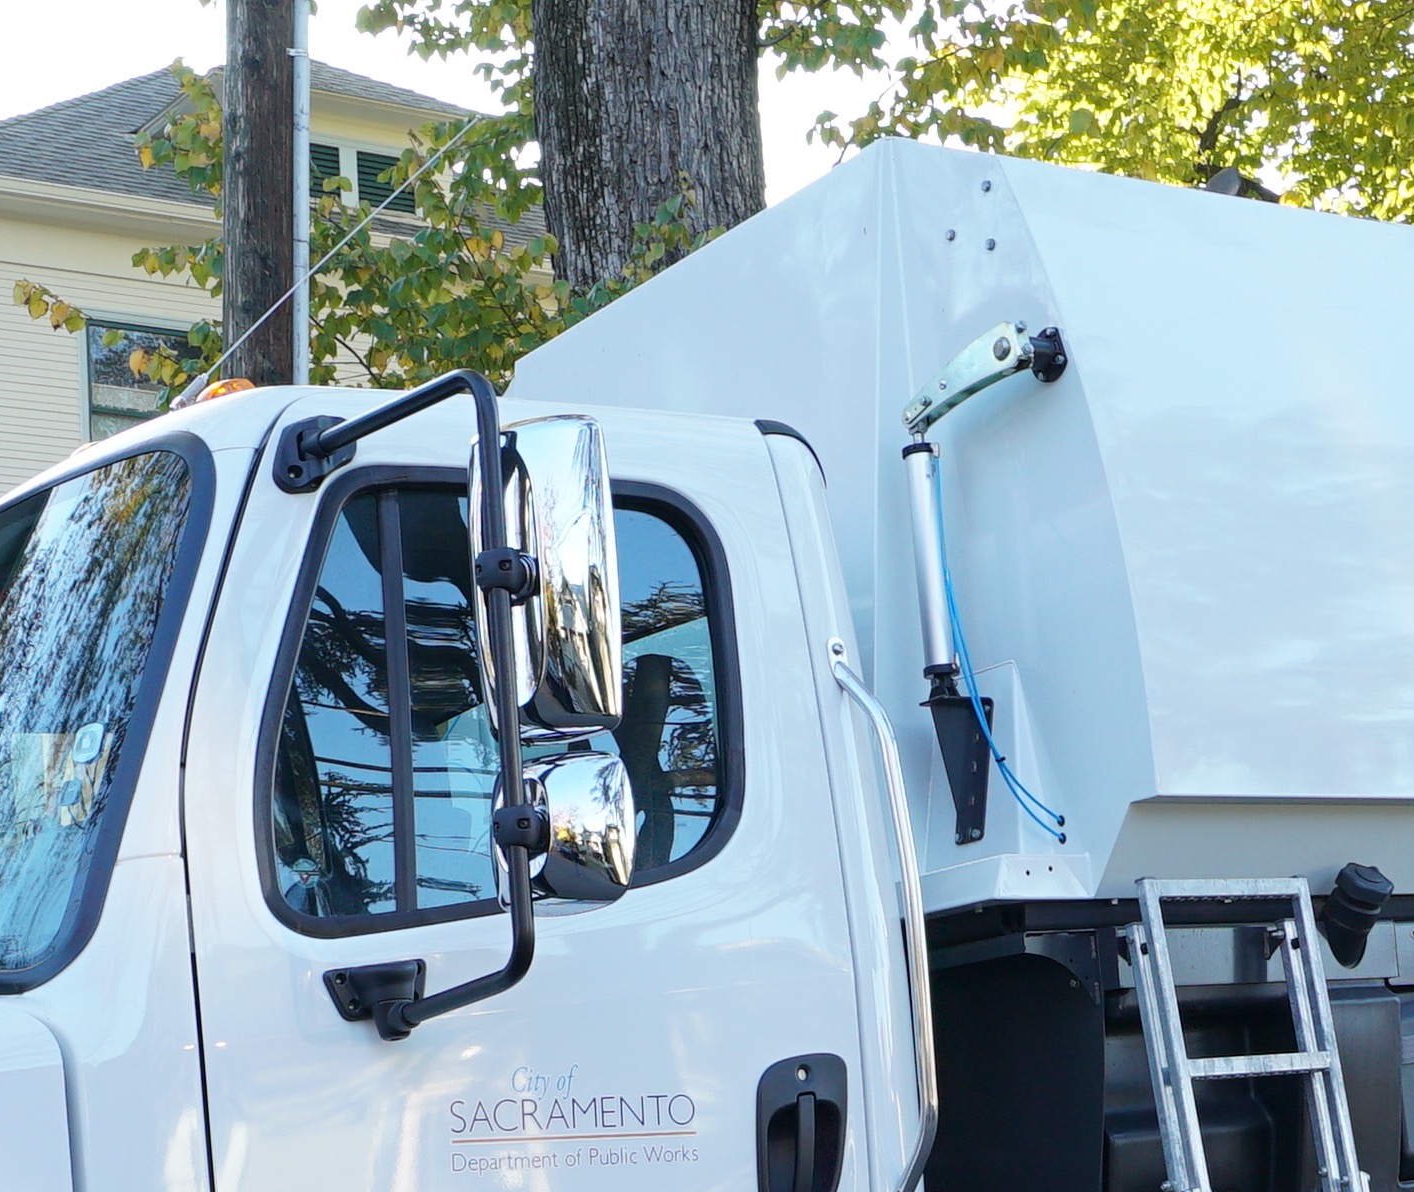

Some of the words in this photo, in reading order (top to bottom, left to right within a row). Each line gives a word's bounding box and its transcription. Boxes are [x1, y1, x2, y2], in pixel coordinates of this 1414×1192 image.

[511, 1066, 551, 1100] City
[556, 1064, 579, 1100] of
[450, 1094, 696, 1134] SACRAMENTO
[451, 1152, 559, 1175] Department
[565, 1148, 583, 1168] of
[588, 1147, 638, 1166] Public
[643, 1145, 699, 1164] Works
